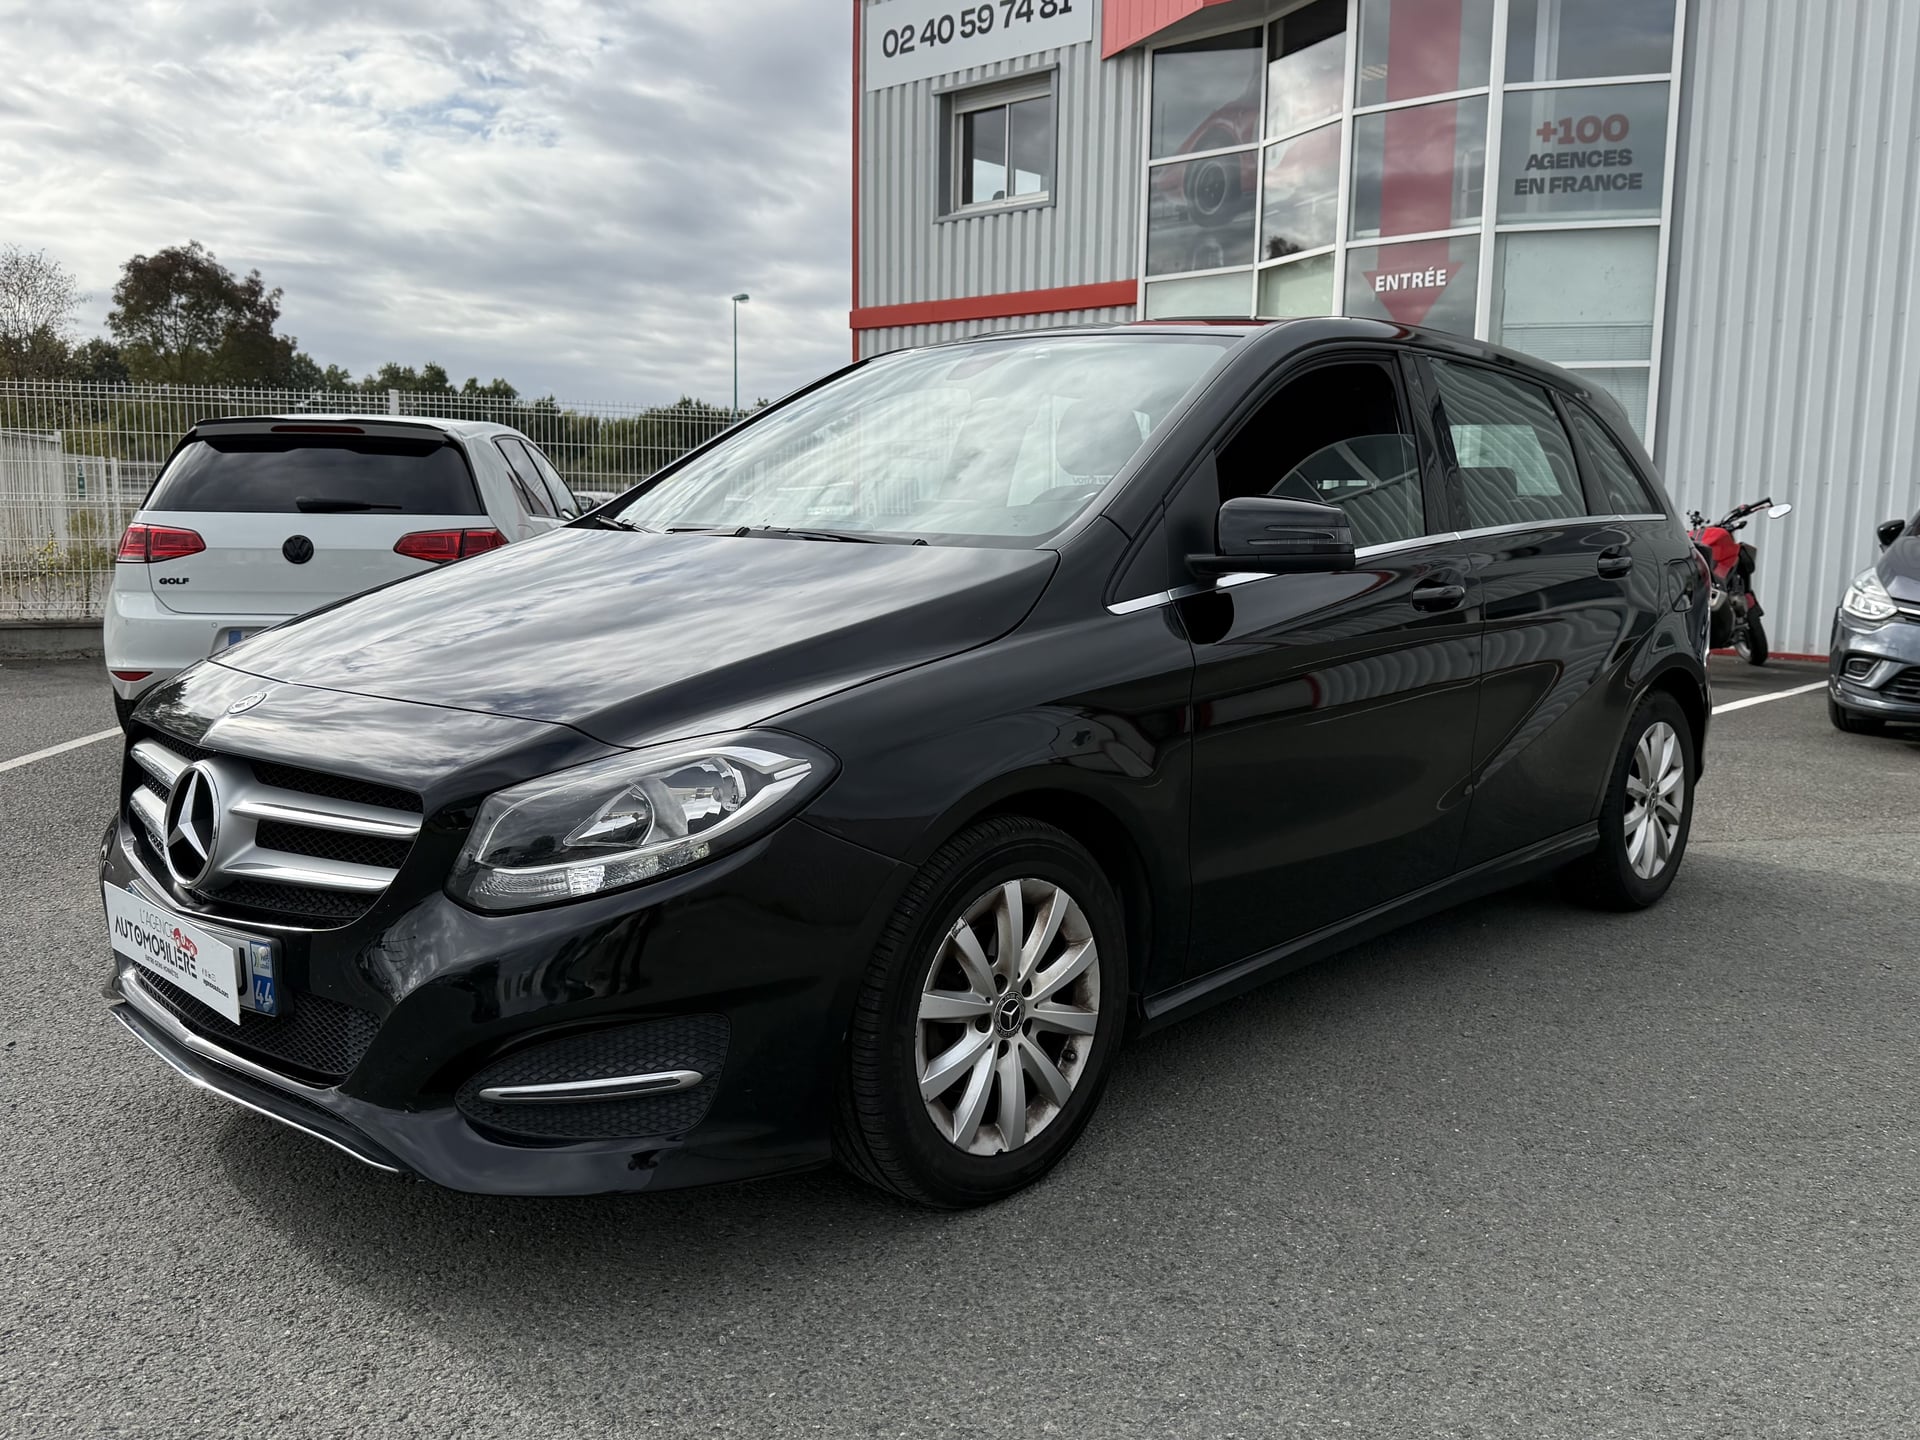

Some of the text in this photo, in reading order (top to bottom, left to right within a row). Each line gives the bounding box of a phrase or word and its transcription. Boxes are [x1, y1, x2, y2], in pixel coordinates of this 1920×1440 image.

[883, 24, 915, 58] 02
[919, 14, 954, 48] 40
[960, 4, 994, 38] 59
[999, 0, 1034, 28] 74
[1536, 113, 1630, 145] +100
[1525, 148, 1633, 171] AGENCES
[1514, 172, 1643, 196] EN FRANCE
[1375, 266, 1447, 292] ENTRÉE
[158, 577, 190, 585] GOLF
